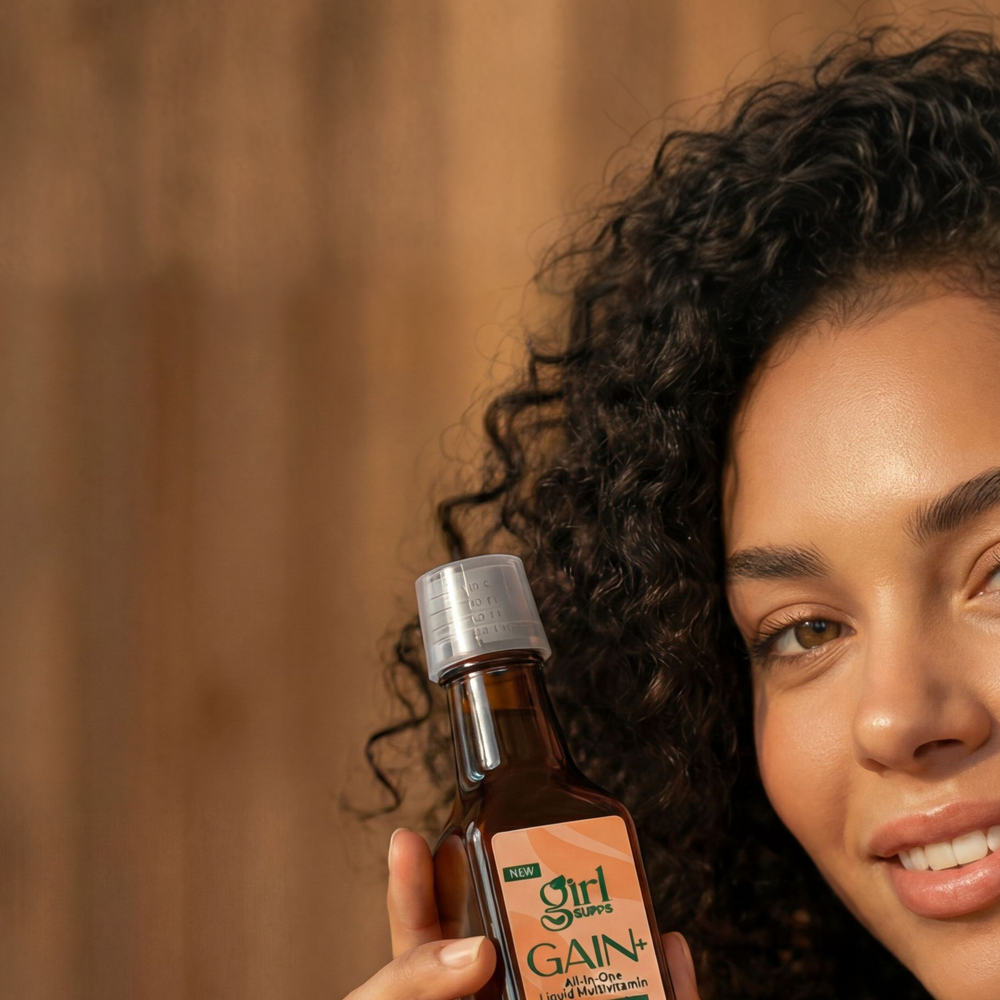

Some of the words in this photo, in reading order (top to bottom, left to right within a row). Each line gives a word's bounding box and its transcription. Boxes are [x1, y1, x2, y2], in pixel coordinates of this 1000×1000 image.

[509, 866, 535, 879] NEW
[539, 865, 611, 932] girl
[573, 903, 614, 919] SUPPS
[565, 971, 623, 988] All-In-One
